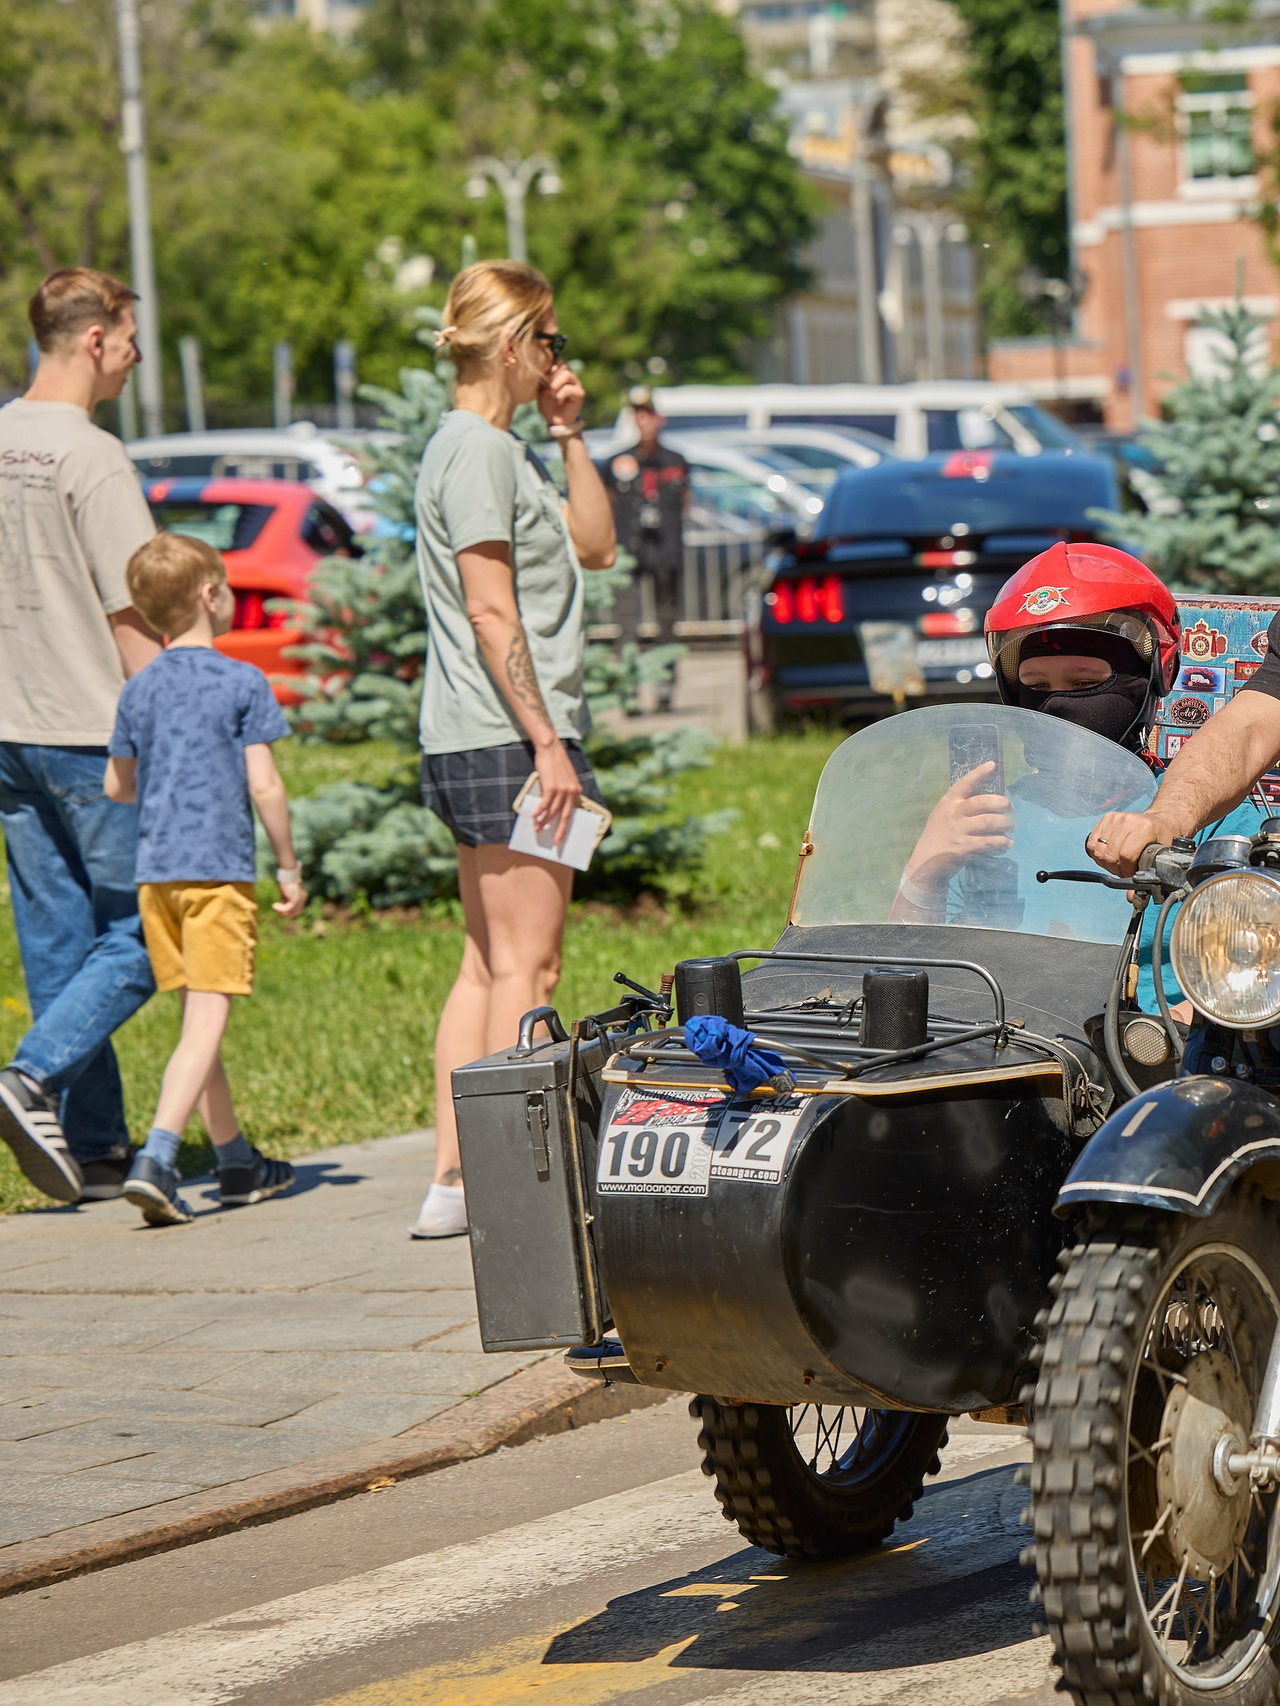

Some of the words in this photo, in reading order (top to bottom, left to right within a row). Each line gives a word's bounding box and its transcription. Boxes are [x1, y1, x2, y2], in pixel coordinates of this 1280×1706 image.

[608, 1130, 691, 1179] 190
[690, 1131, 715, 1181] 2024
[719, 1117, 782, 1162] 72
[601, 1183, 706, 1195] www.motoangar.com
[711, 1167, 779, 1182] otoangar.com
